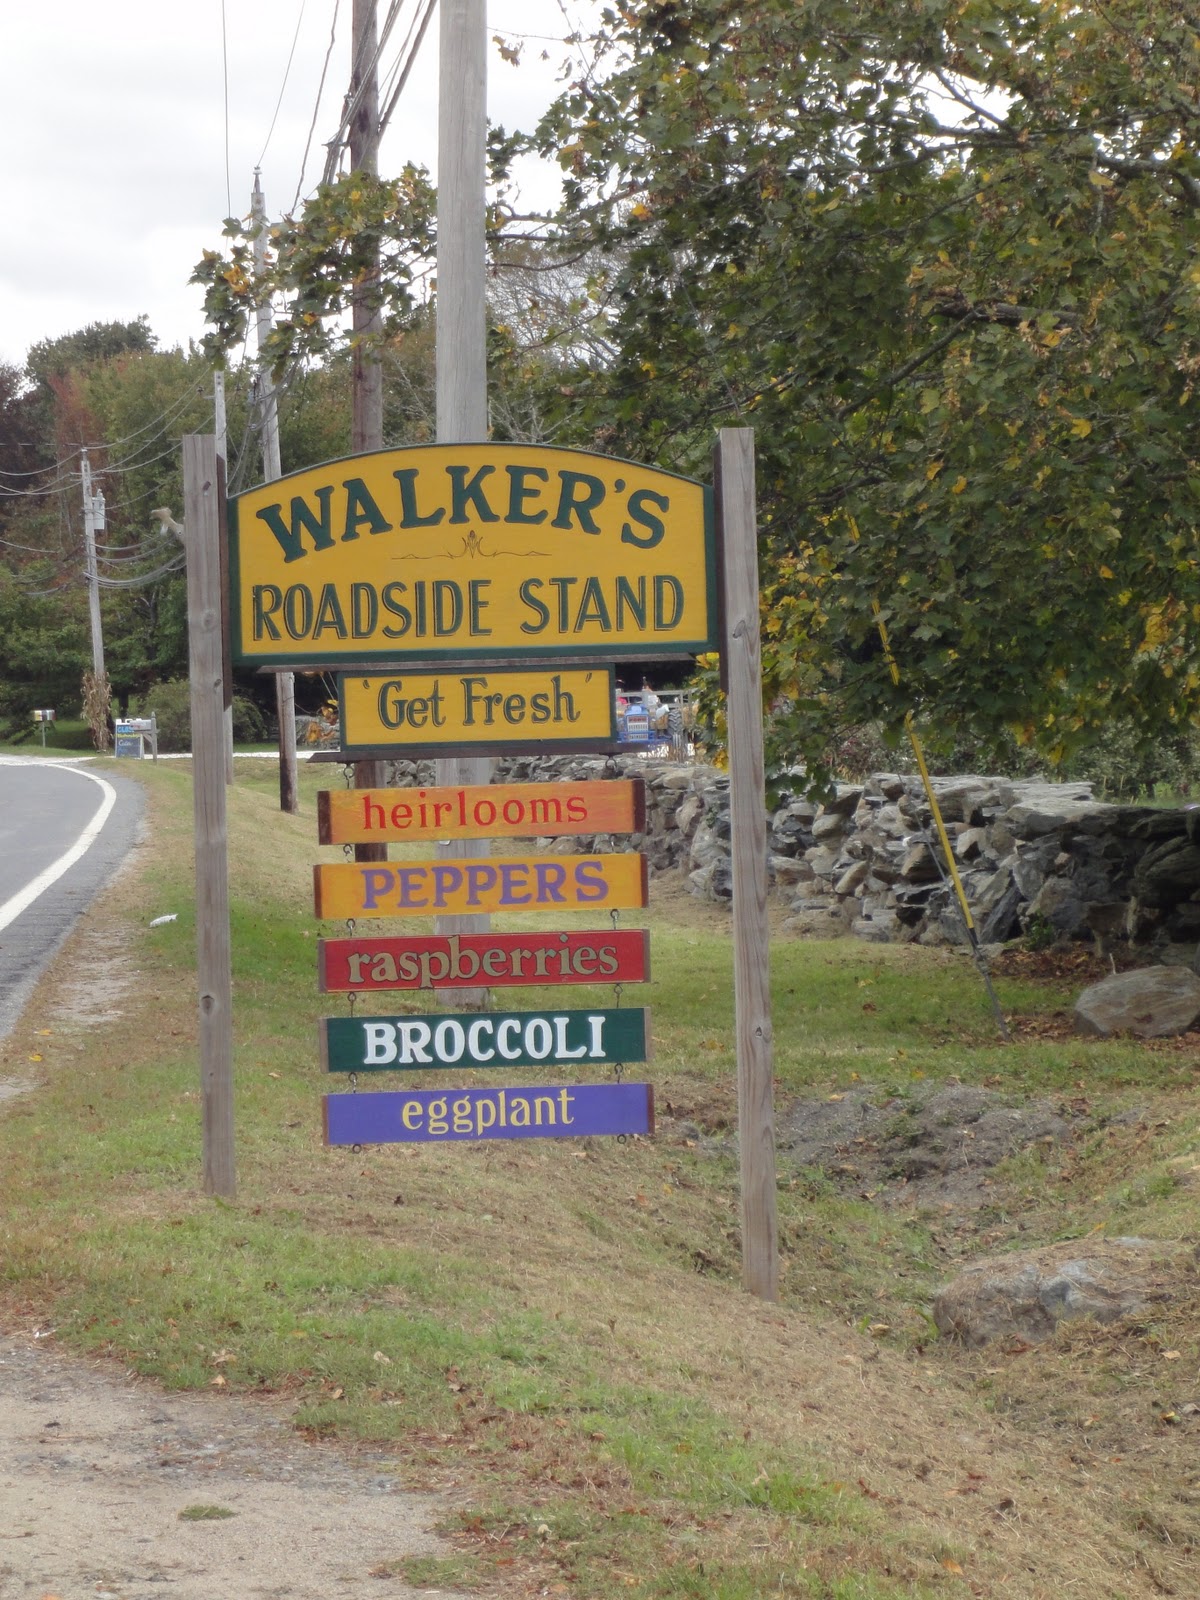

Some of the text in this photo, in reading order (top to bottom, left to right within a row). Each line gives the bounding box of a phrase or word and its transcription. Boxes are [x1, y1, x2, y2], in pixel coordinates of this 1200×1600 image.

[256, 465, 670, 563] WALKER'S
[252, 574, 684, 641] ROADSIDE STAND
[363, 790, 588, 830] heirlooms
[361, 861, 609, 909] PEPPERS
[347, 933, 620, 989] raspberries
[362, 1016, 606, 1064] BROCCOLI
[402, 1088, 575, 1135] eggplant
